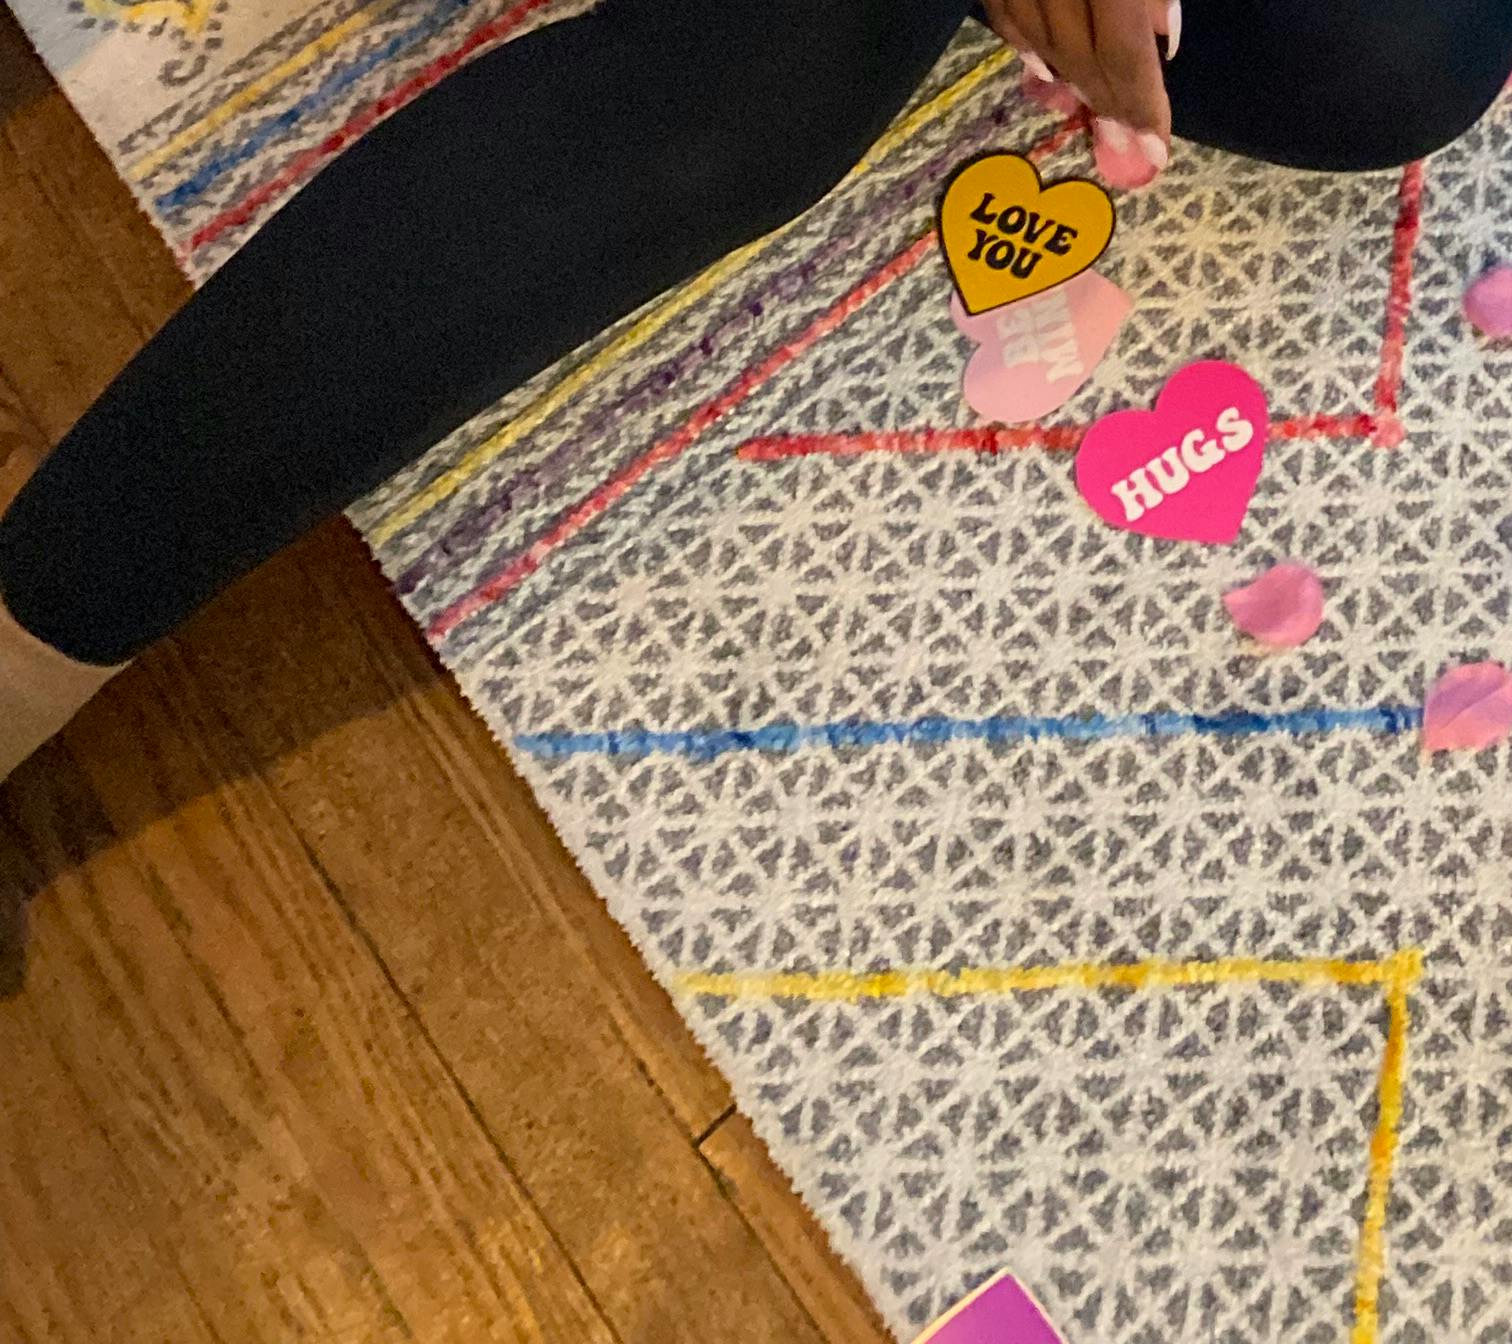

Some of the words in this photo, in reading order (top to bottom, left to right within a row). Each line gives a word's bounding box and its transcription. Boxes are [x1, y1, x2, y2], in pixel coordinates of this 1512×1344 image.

[967, 228, 1042, 280] YOU
[969, 192, 1078, 256] LOVE
[1031, 287, 1085, 385] MIN
[1110, 406, 1254, 522] HUGS
